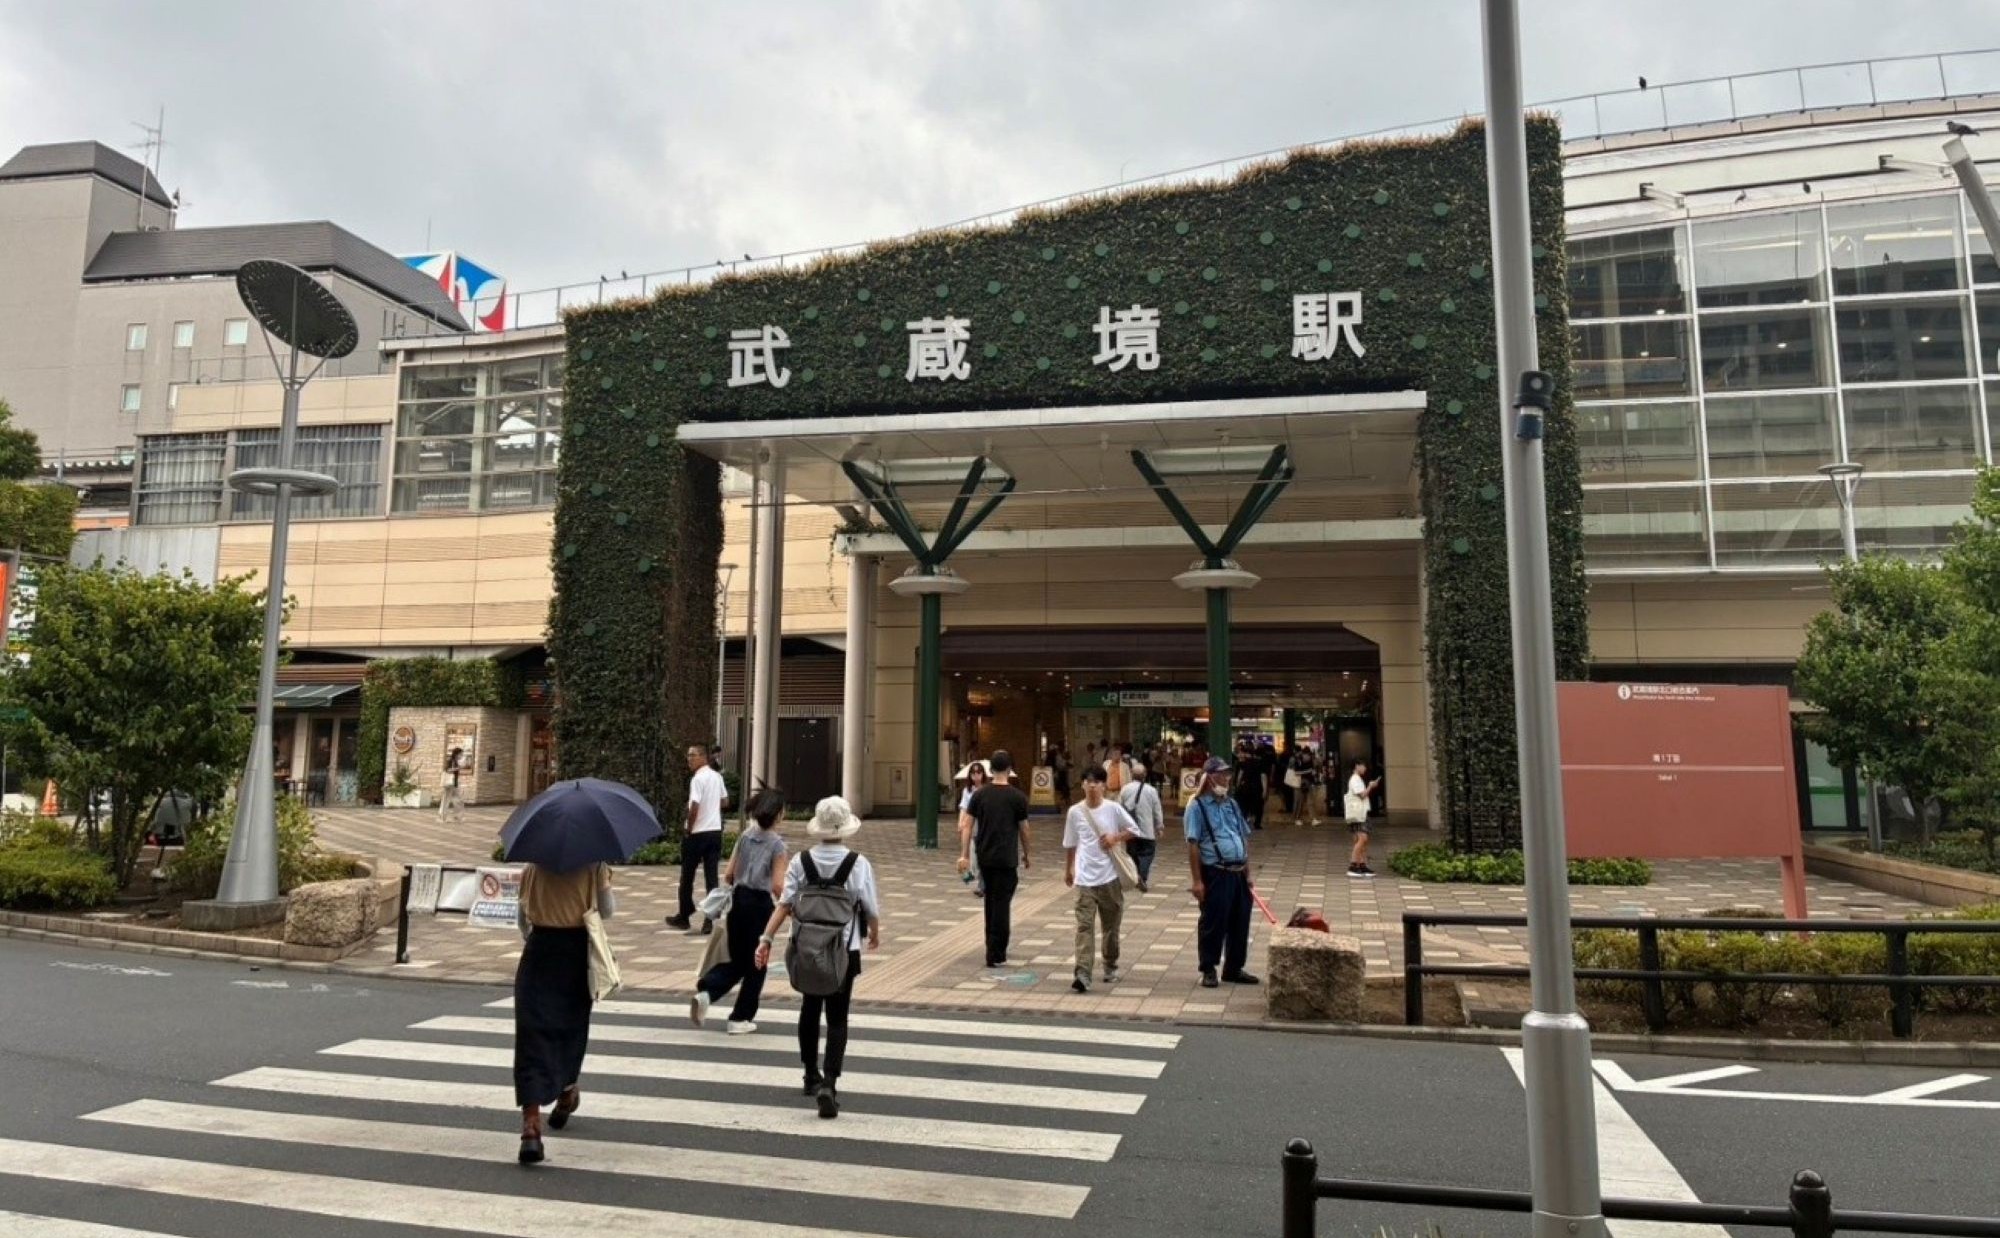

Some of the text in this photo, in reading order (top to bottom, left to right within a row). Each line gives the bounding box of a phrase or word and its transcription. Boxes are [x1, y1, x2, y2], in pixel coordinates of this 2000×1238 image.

[727, 290, 1366, 388] 武蔵境駅
[1101, 692, 1118, 704] JR
